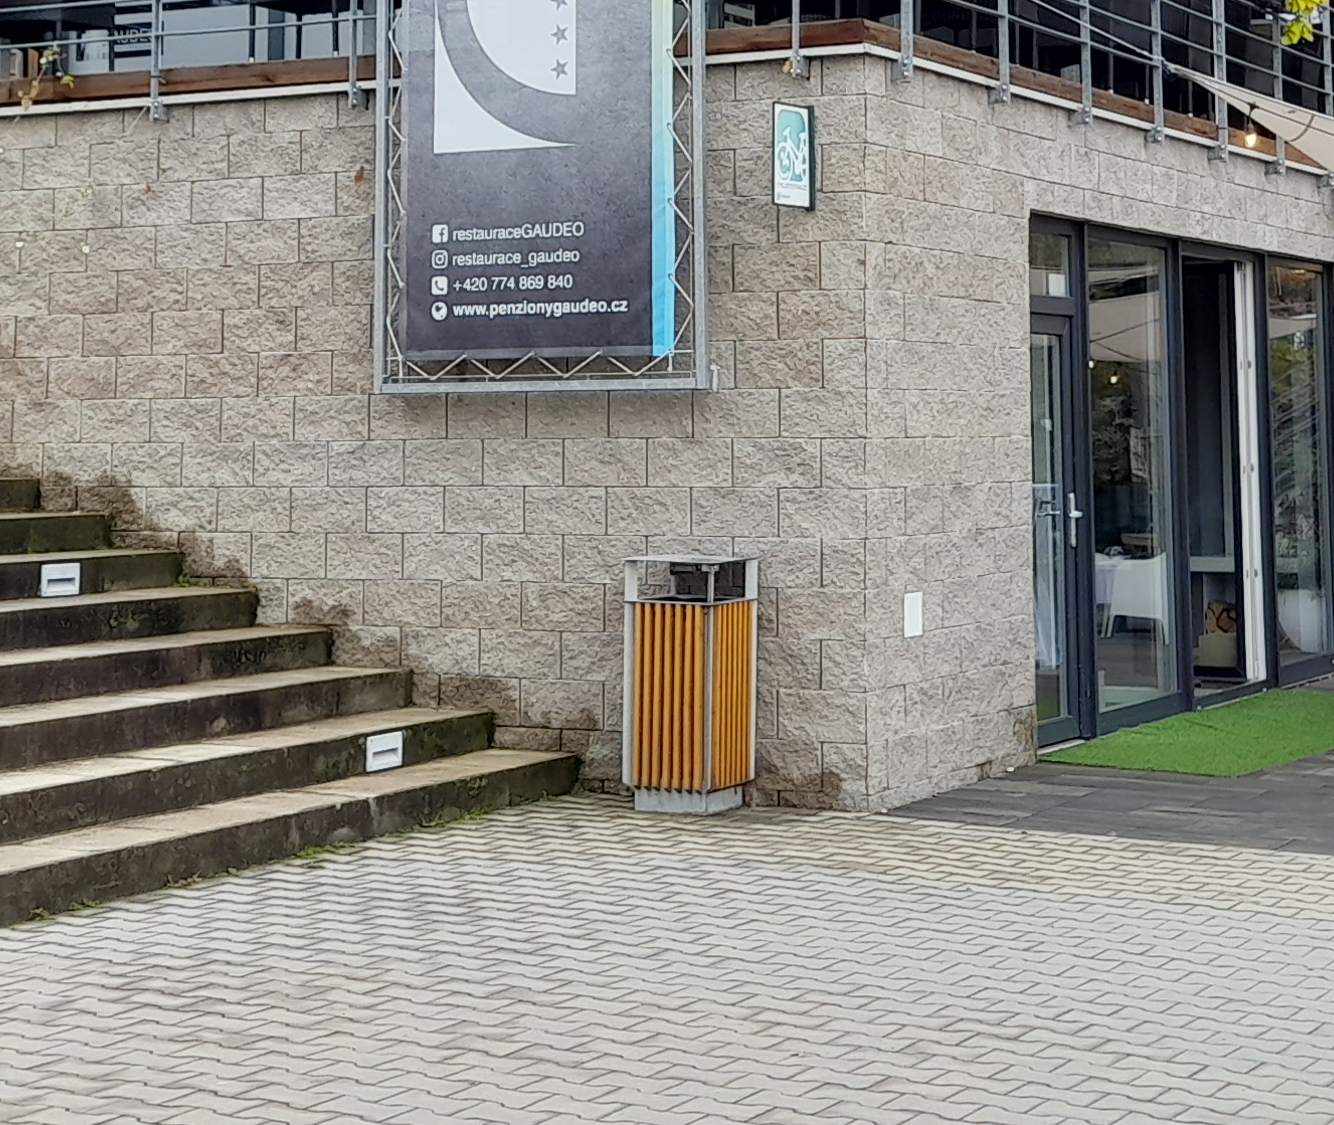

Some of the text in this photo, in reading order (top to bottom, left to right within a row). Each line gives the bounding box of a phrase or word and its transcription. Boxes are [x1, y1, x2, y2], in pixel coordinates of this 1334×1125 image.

[452, 221, 585, 241] restauraceGAUDEO
[452, 248, 581, 269] restaurace_gaudeo
[453, 274, 573, 292] +420 774 869 840
[452, 298, 629, 319] www.penzionygaudeo.cz
